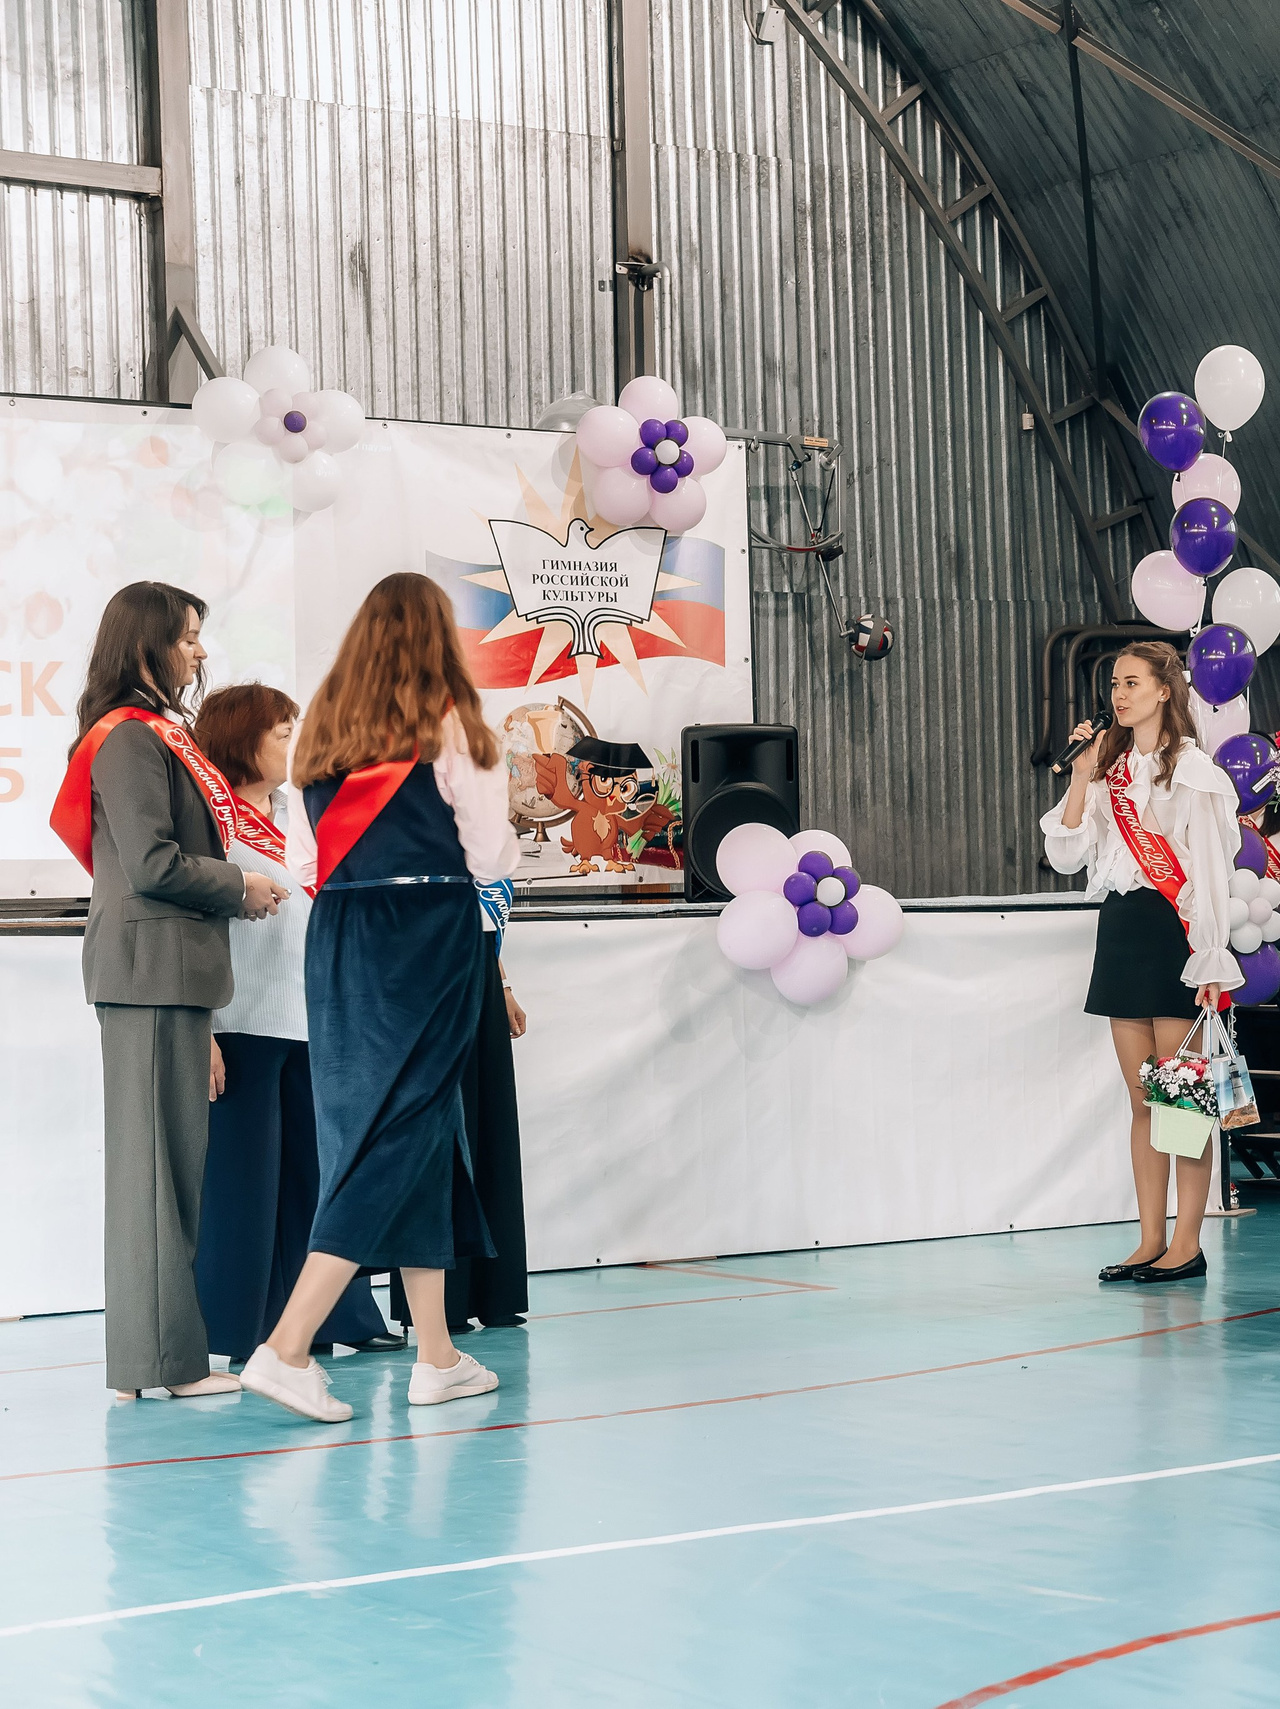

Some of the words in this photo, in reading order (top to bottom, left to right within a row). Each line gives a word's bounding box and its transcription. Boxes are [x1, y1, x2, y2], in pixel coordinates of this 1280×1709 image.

[541, 559, 618, 572] ГИМНАЗИЯ
[531, 572, 629, 587] РОССИЙСКОЙ
[541, 589, 618, 603] КУЛЬТУРЫ
[165, 727, 229, 803] Классный
[1142, 852, 1180, 882] 2025
